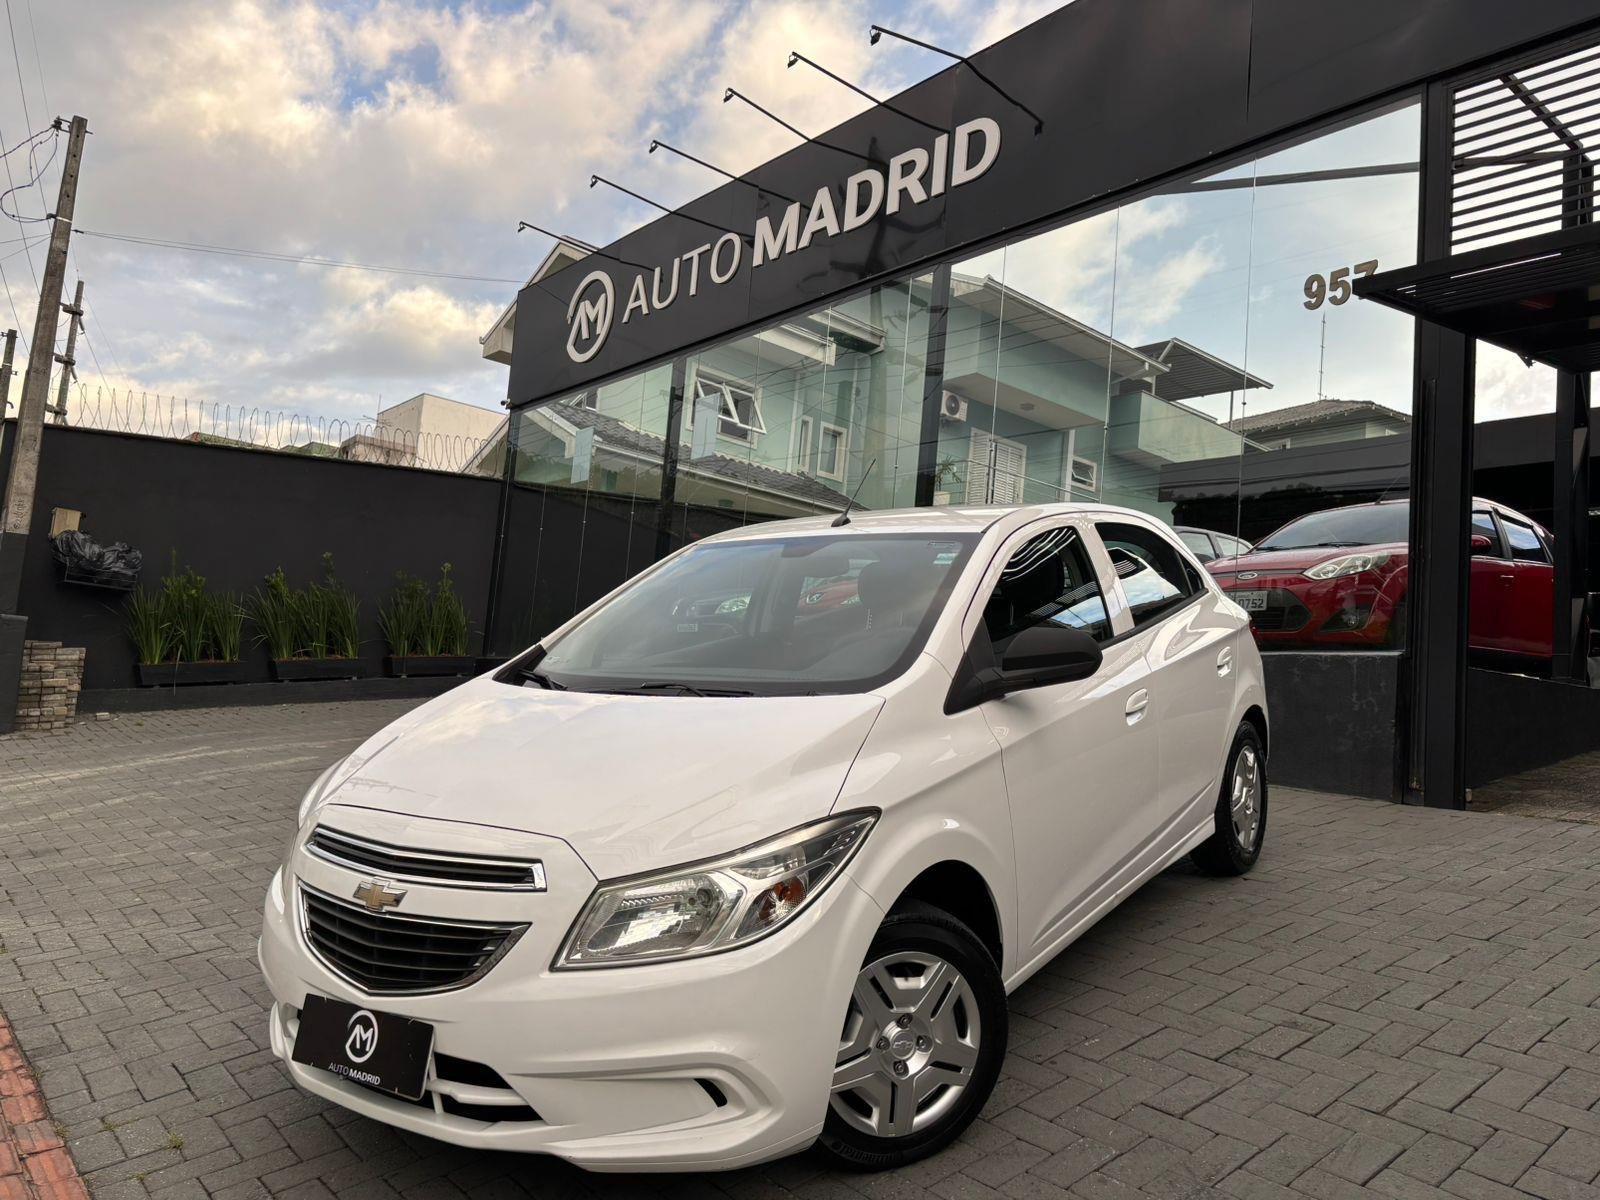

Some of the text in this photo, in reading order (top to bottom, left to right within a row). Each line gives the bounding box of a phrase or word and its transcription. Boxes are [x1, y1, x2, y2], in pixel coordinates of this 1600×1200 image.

[622, 116, 1001, 324] AUTO MADRID
[328, 1062, 381, 1085] AUTO MADRID
